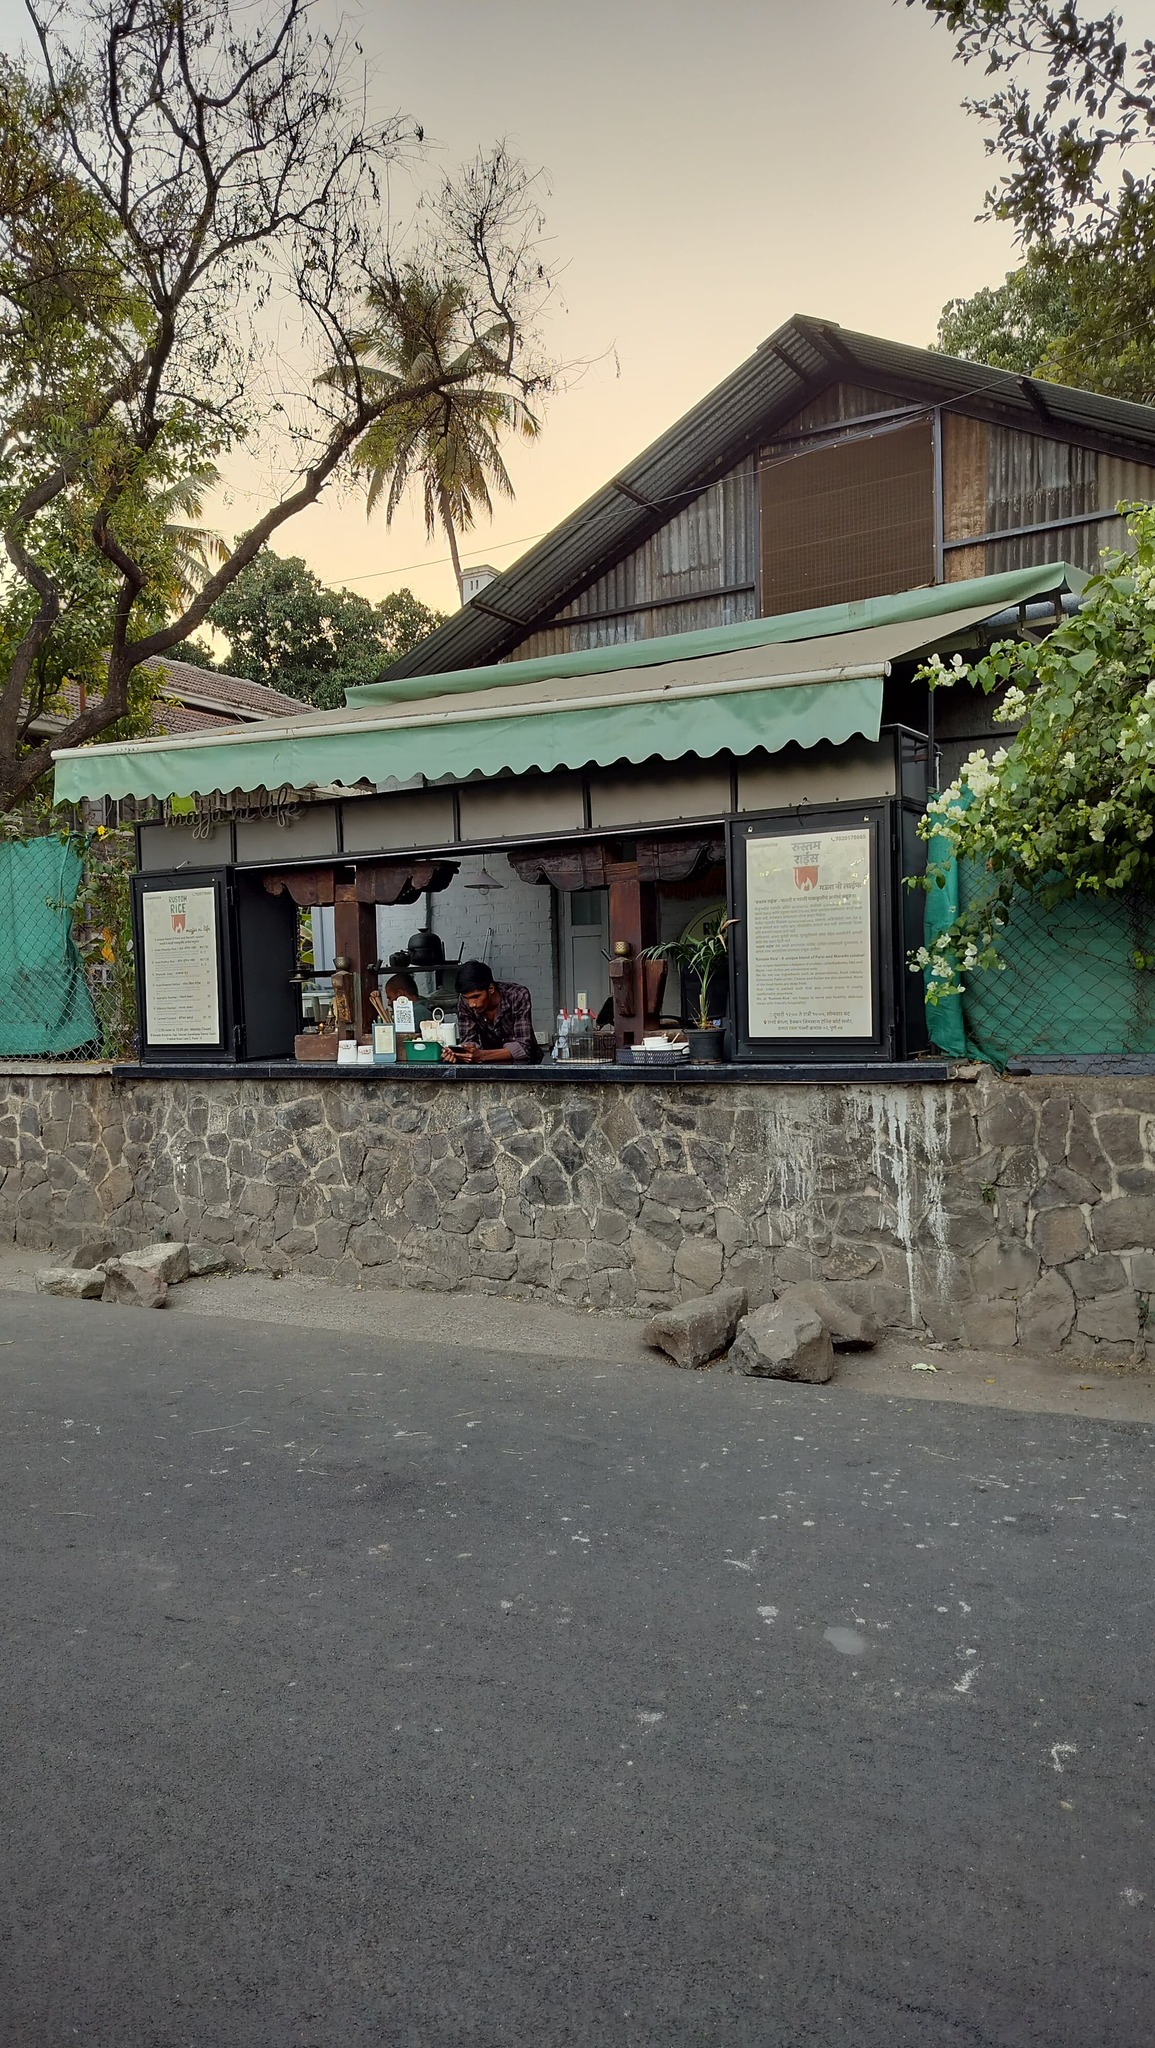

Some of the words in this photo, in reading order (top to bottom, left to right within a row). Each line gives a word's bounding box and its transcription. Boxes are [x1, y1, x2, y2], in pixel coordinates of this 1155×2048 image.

[258, 787, 299, 828] life
[791, 841, 821, 852] रुस्तम
[794, 852, 820, 864] राईस
[170, 904, 186, 914] RICE
